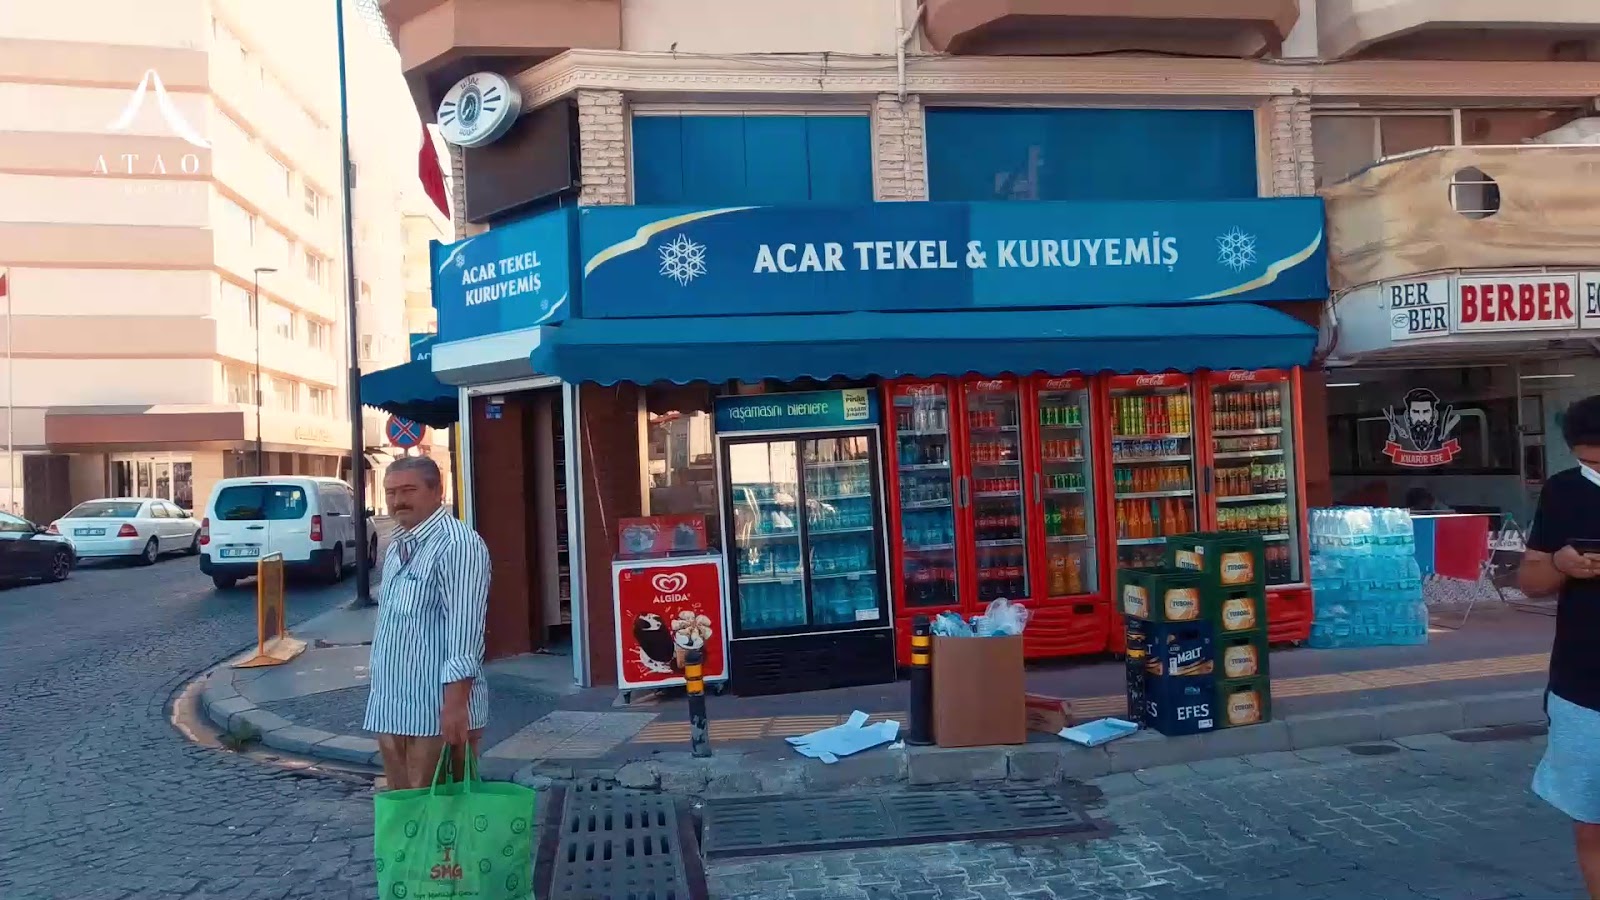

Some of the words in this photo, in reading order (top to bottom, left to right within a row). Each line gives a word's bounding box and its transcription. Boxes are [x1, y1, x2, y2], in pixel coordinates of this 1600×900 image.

[753, 243, 846, 273] ACAR
[854, 240, 957, 271] TEKEL
[966, 240, 988, 269] &
[998, 231, 1179, 273] KURUYEMİŞ
[462, 263, 496, 285] ACAR
[499, 251, 541, 275] TEKEL
[465, 271, 542, 306] KURUYEMİŞ
[1390, 282, 1430, 307] BER
[1460, 282, 1574, 323] BERBER
[1408, 306, 1447, 331] BER
[1136, 373, 1166, 386] Coca-Cola
[1176, 703, 1210, 720] EFES
